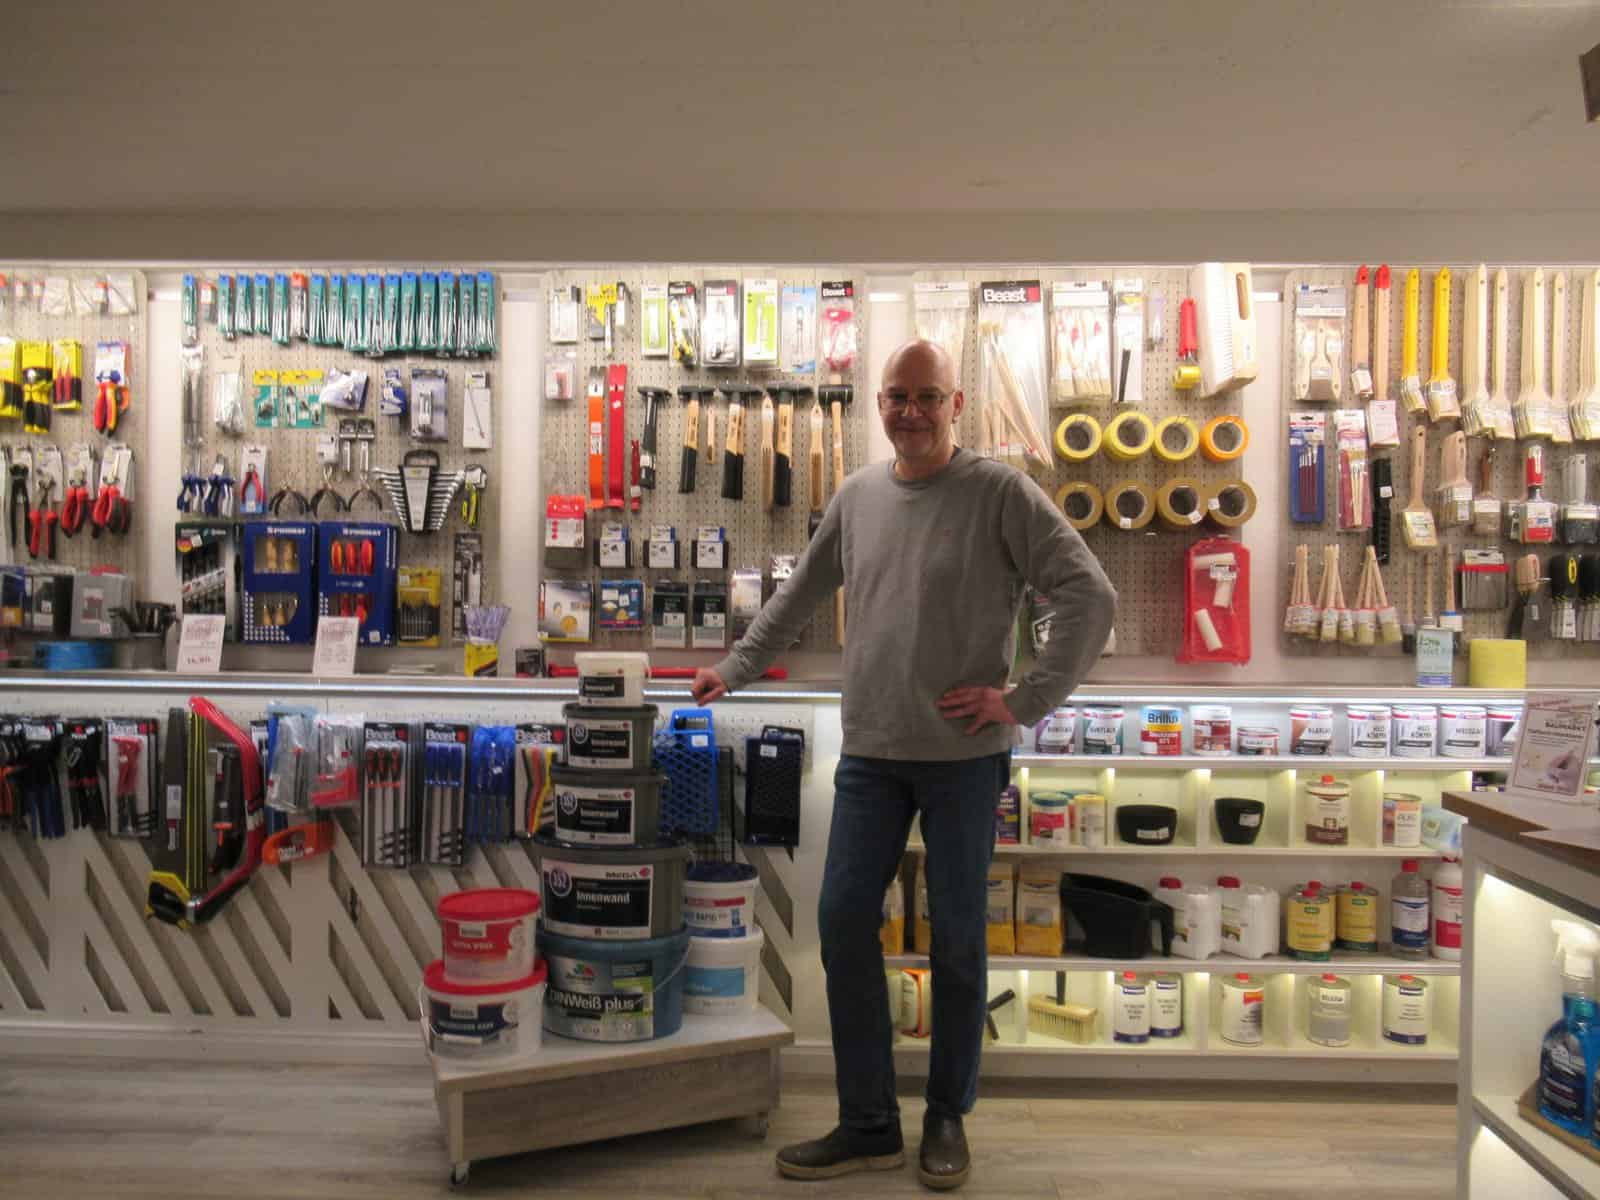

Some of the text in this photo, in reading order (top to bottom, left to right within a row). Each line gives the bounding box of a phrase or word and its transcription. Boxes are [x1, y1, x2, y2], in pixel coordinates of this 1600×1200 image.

[983, 288, 1026, 303] Beast
[365, 730, 395, 741] Beast
[426, 731, 456, 742] Beast
[516, 730, 552, 742] Beast
